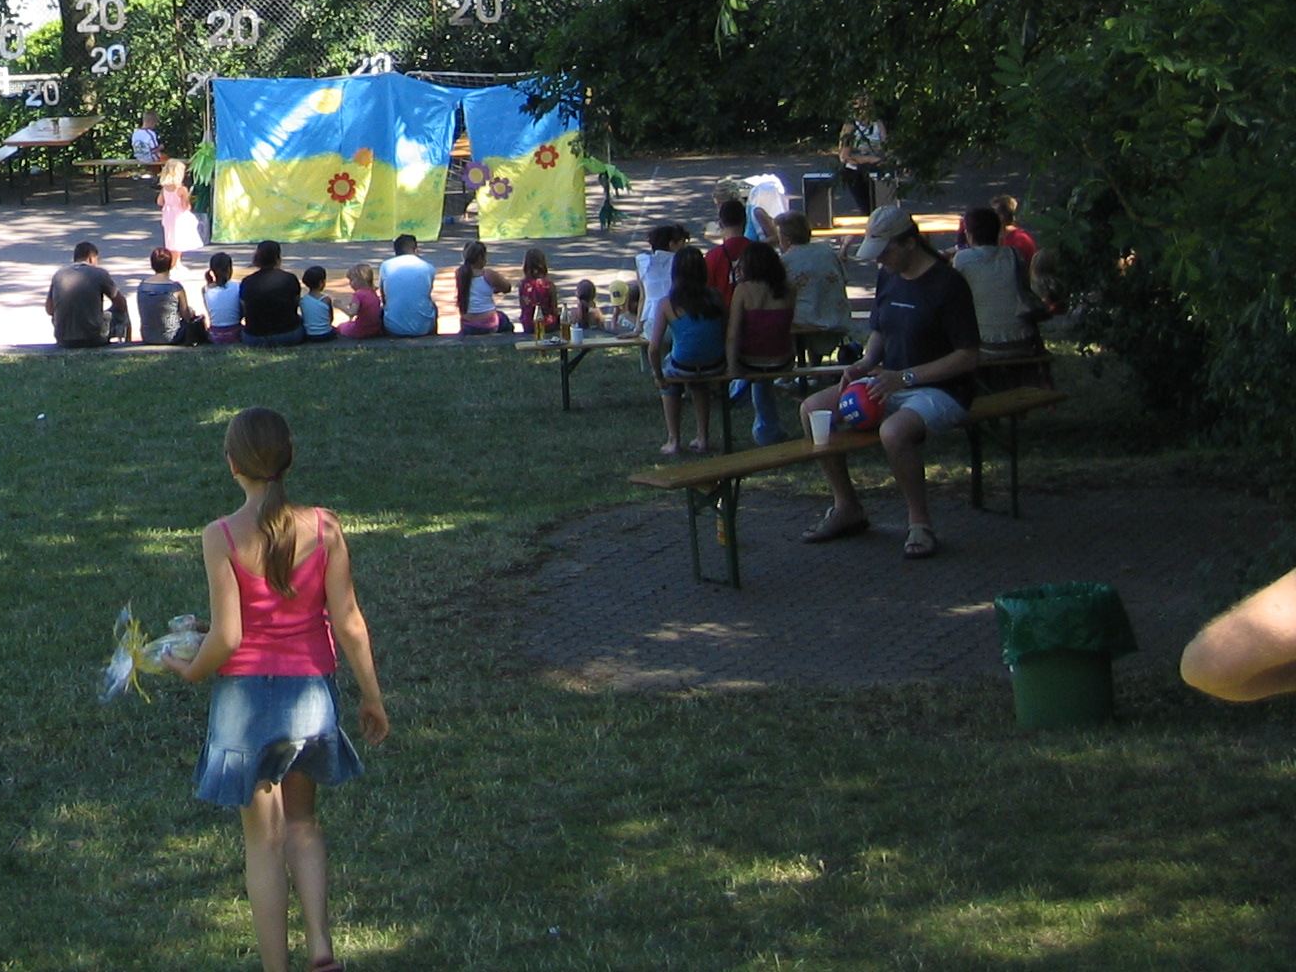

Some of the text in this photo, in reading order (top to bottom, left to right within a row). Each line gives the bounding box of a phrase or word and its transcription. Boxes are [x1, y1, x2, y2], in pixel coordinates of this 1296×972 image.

[207, 9, 259, 47] 20
[91, 44, 126, 74] 20
[25, 80, 60, 107] 20
